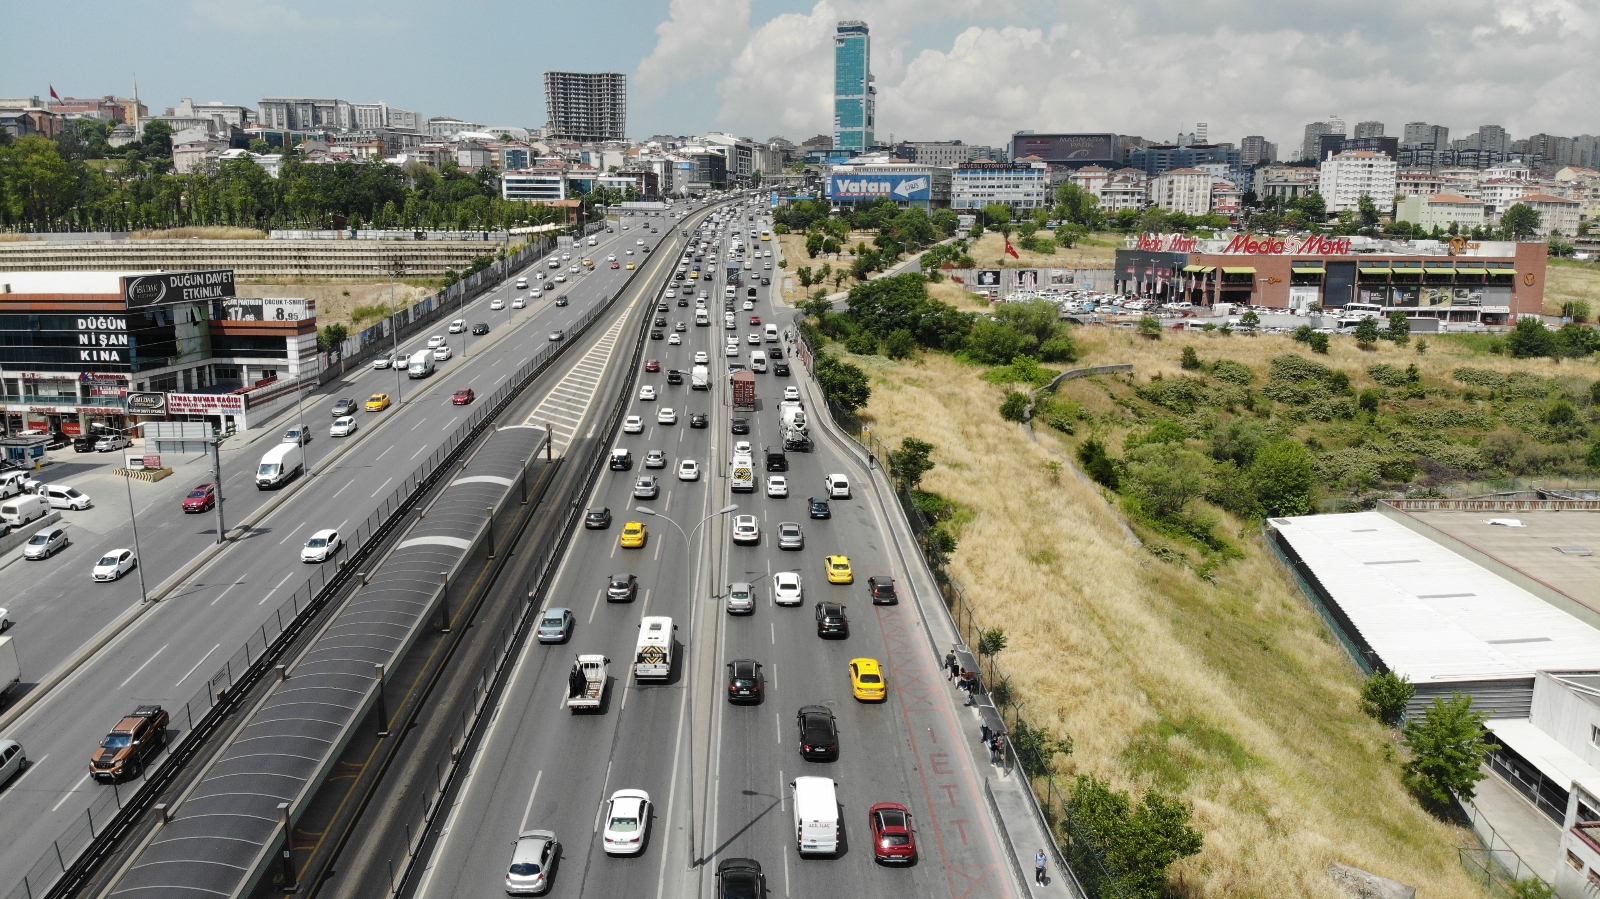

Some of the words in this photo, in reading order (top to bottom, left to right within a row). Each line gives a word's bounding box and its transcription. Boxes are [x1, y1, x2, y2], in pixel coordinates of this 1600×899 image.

[836, 179, 891, 192] Vatan
[1168, 234, 1198, 252] Markt
[1222, 234, 1285, 254] Media
[1297, 234, 1352, 254] Markt
[170, 273, 204, 287] DÜĞÜN
[205, 272, 232, 284] DAVET
[183, 285, 222, 299] ETKİNLİK
[77, 316, 127, 330] DÜĞÜN
[79, 332, 128, 347] NİŞAN
[80, 350, 120, 361] KINA
